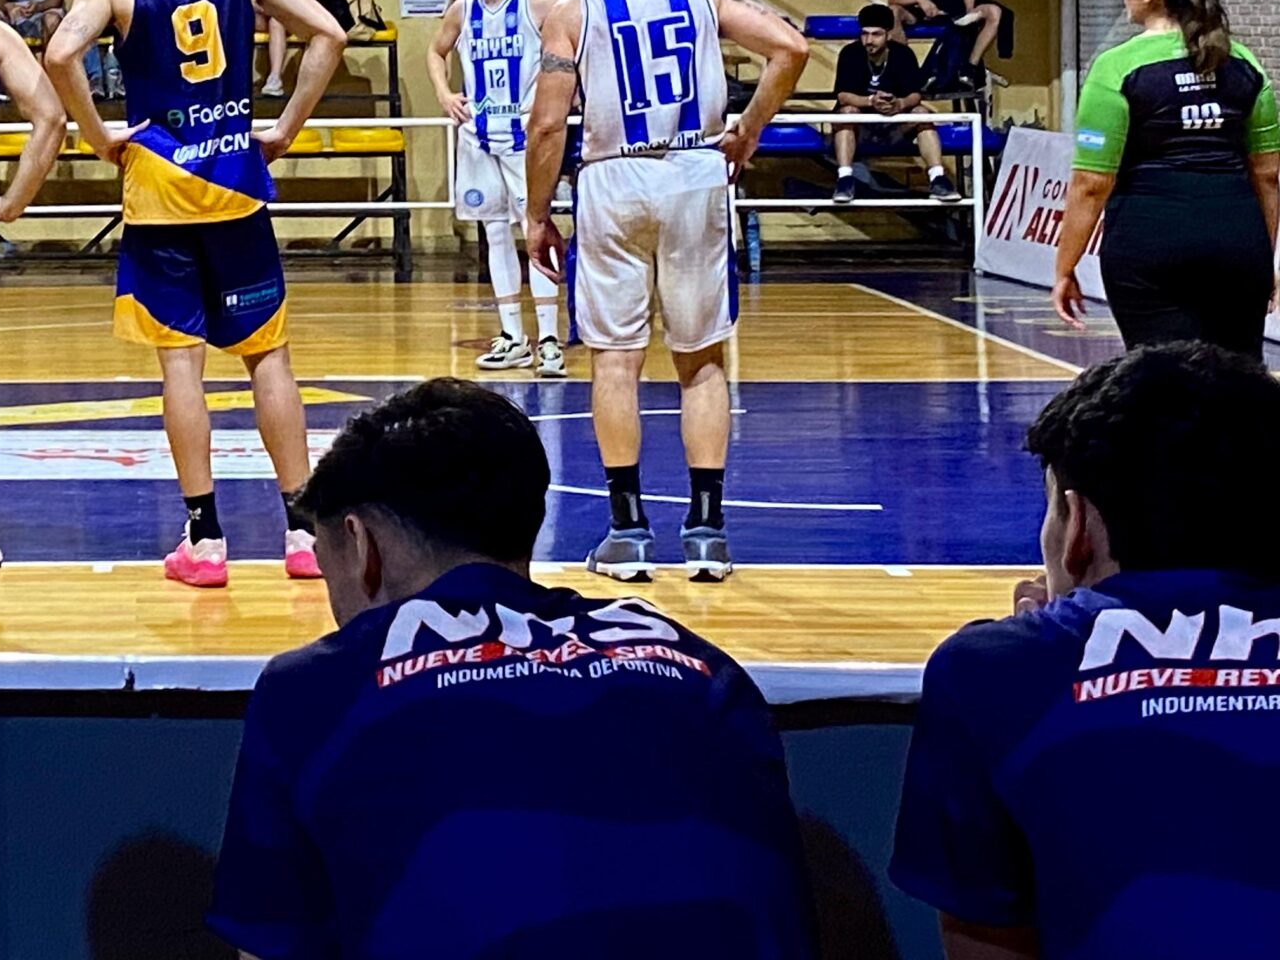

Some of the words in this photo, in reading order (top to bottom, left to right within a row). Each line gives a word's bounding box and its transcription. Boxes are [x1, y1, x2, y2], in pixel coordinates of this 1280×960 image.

[612, 10, 694, 115] 15
[489, 68, 506, 89] 12
[188, 98, 250, 127] Faeac
[382, 644, 484, 688] NUEVE
[614, 645, 704, 671] SPORT
[588, 657, 684, 681] DEPORTIVA
[1078, 668, 1194, 703] NUEVE
[1214, 668, 1280, 687] REY
[1141, 694, 1280, 718] INDUMENTAR
